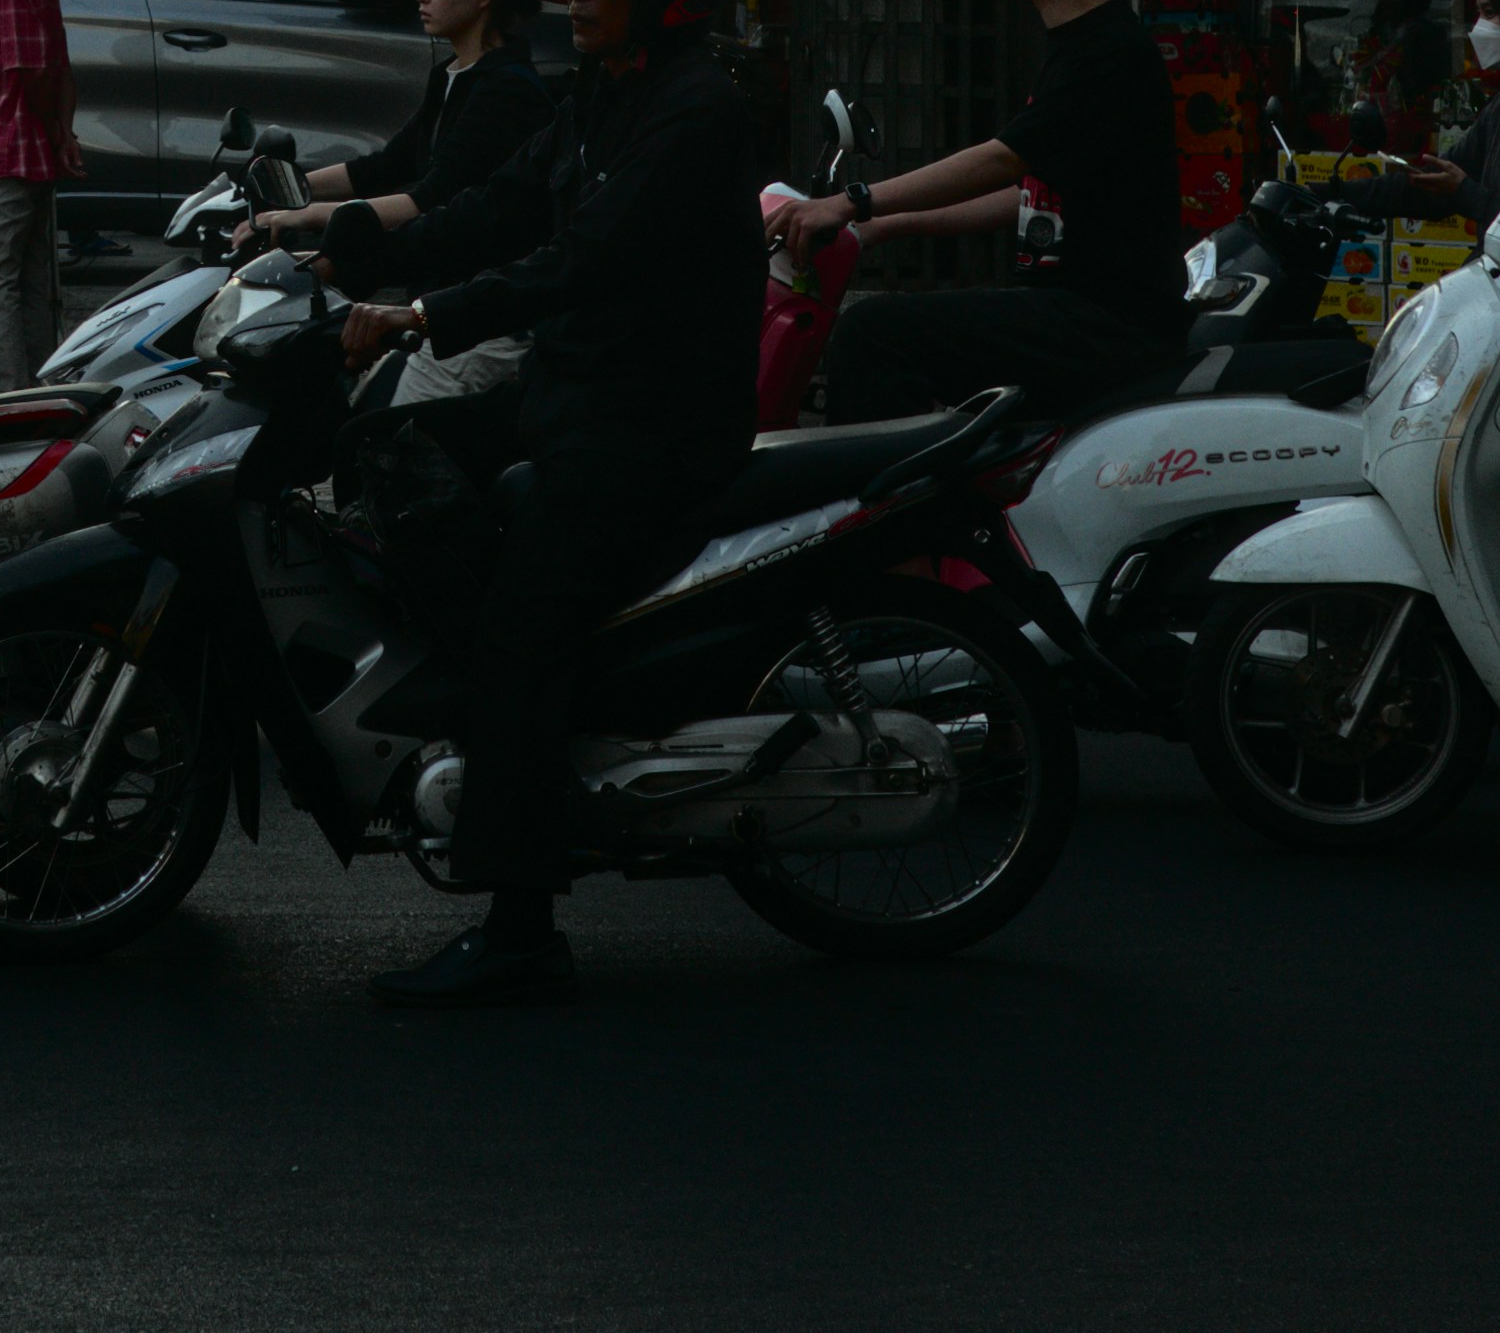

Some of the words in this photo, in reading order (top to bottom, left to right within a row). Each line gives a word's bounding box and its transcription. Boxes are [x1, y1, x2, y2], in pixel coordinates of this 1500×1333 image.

[132, 378, 184, 400] HONDA
[1205, 444, 1341, 465] SCOOPY
[260, 583, 330, 598] HONDA
